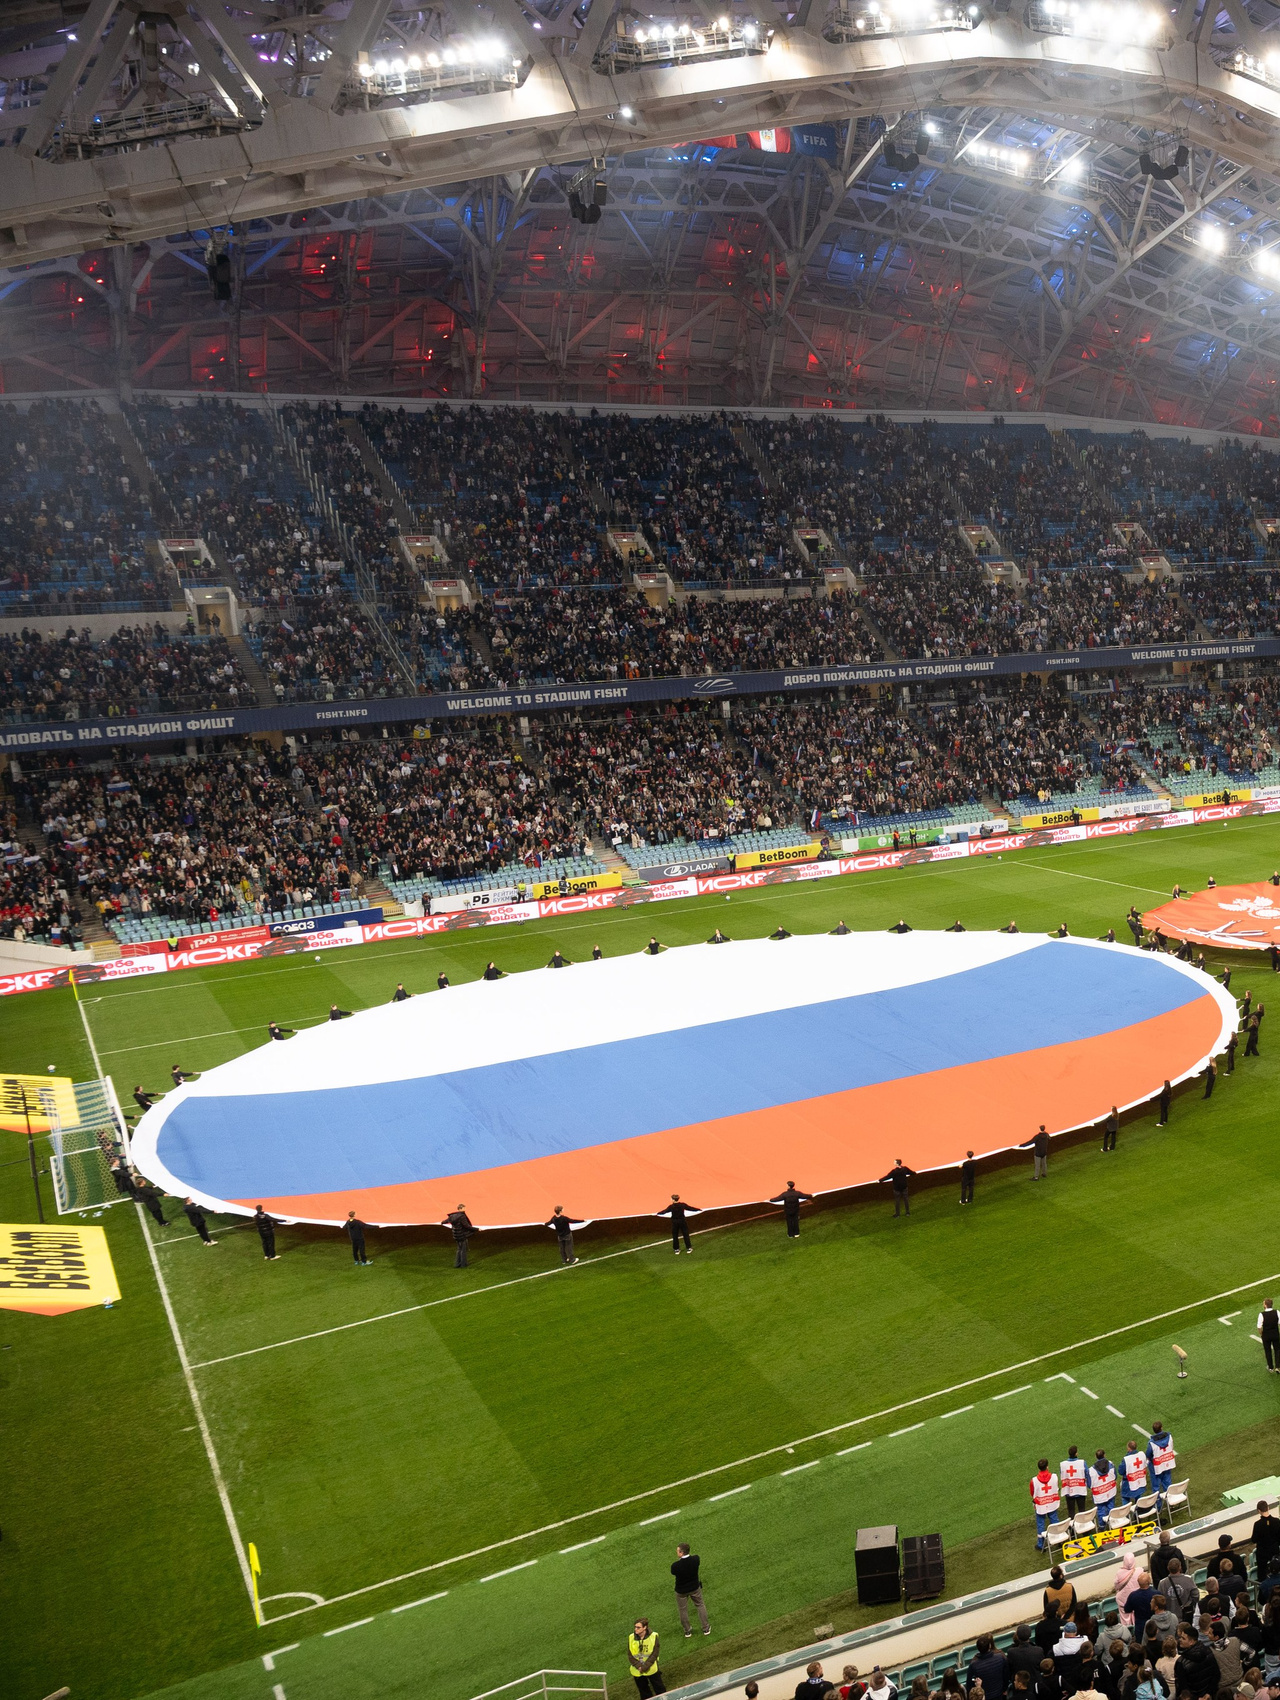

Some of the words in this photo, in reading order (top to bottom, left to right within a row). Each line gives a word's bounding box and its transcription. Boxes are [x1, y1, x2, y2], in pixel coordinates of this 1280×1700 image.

[803, 134, 828, 147] FIFA
[1131, 649, 1175, 660] WELCOME
[1177, 648, 1188, 657] TO
[1191, 646, 1230, 657] STADIUM
[1232, 644, 1255, 654] FISHT
[784, 673, 821, 686] ДОБРО
[823, 668, 896, 682] ПОЖАЛОВАТЬ
[899, 667, 913, 677] НА
[915, 663, 962, 676] СТАДИОН
[964, 661, 995, 672] ФИШТ
[447, 695, 512, 710] WELCOME
[515, 695, 531, 705] TO
[535, 691, 591, 704] STADIUM
[594, 687, 628, 699] FISHT
[316, 708, 368, 720] FISHT.INFO
[78, 728, 99, 740] НА
[106, 721, 182, 737] СТАДИОН
[187, 717, 234, 730] ФИШТ
[759, 849, 808, 863] BetBoom
[690, 863, 714, 872] LADA
[544, 880, 597, 895] BeBoom
